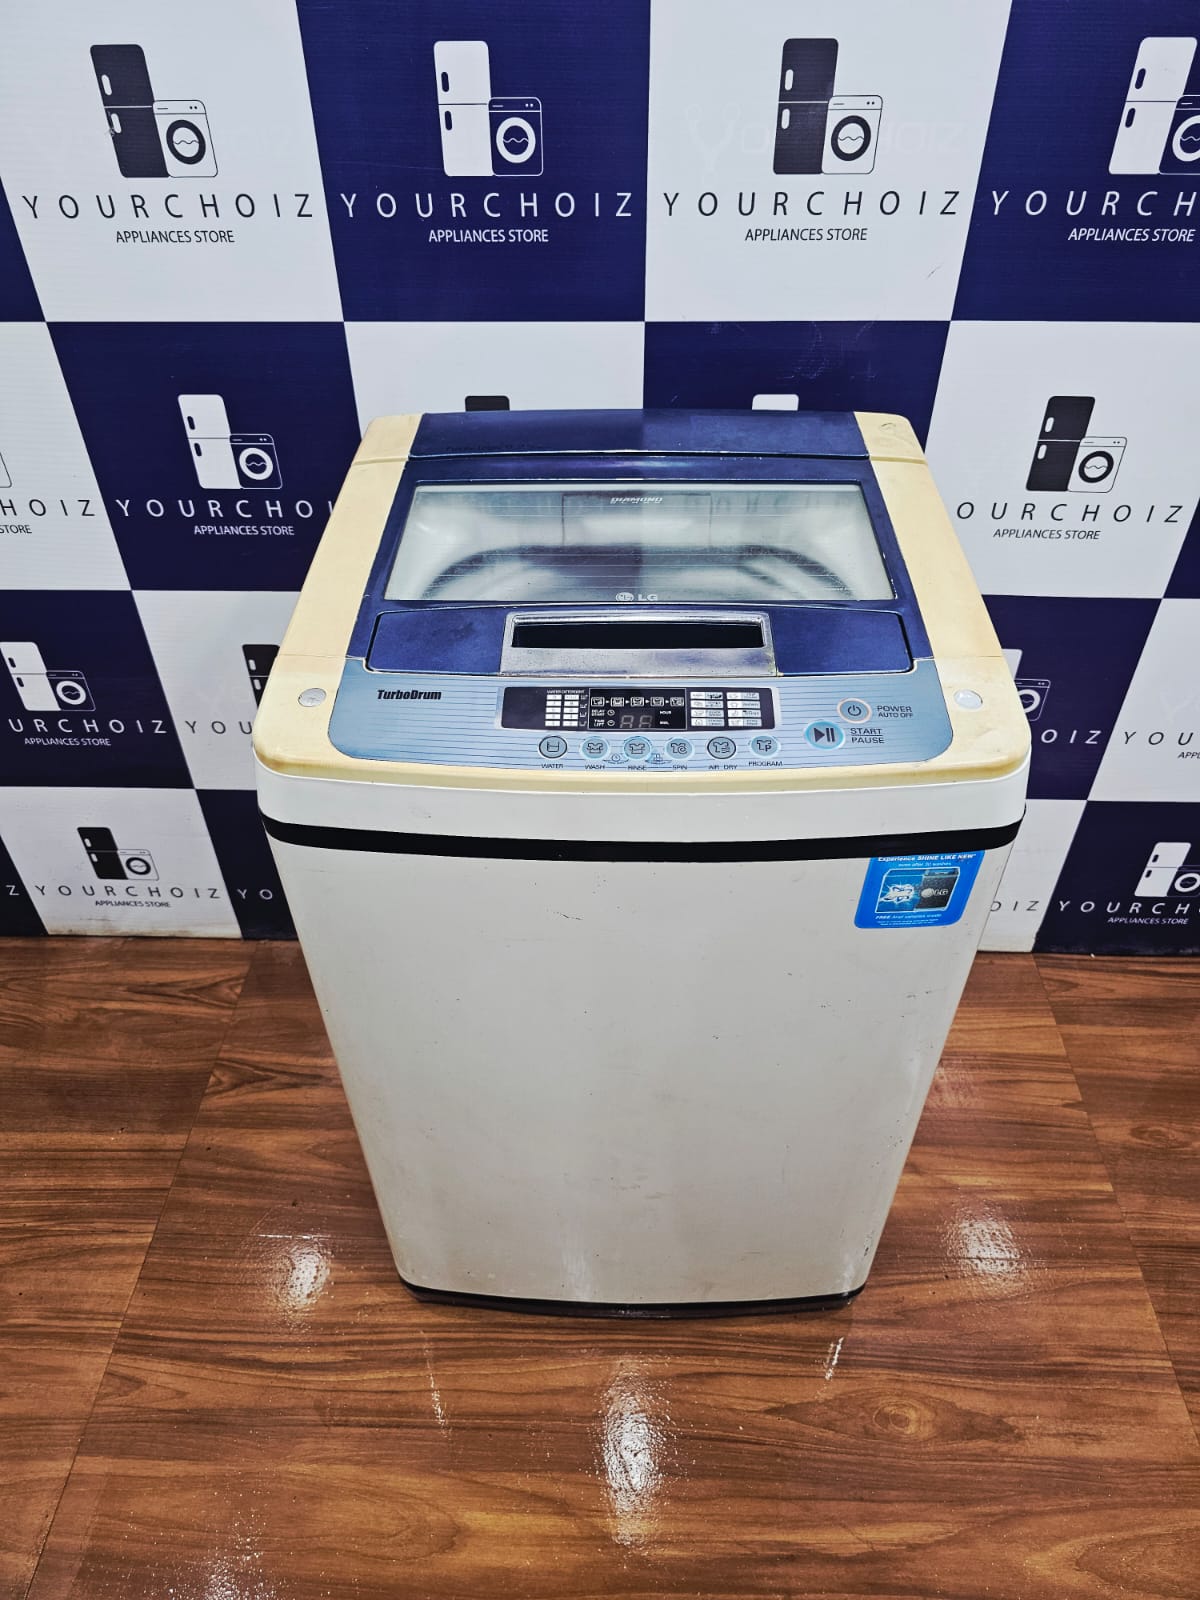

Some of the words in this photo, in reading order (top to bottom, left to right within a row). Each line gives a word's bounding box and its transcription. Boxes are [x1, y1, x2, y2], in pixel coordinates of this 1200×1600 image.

[22, 194, 312, 218] YOURCHOIZ
[341, 193, 631, 217] YOURCHOIZ
[664, 191, 959, 216] YOURCHOIZ
[993, 191, 1196, 216] YOURCH
[116, 230, 192, 243] APPLIANCES
[193, 230, 235, 243] STORE
[428, 229, 506, 243] APPLIANCES
[508, 229, 549, 243] STORE
[745, 229, 823, 241] APPLIANCES
[827, 228, 867, 240] STORE
[1067, 227, 1151, 242] APPLIANCES
[1151, 228, 1197, 242] STORE
[957, 502, 1183, 522] OURCHOIZ
[194, 525, 259, 536] APPLIANCES
[259, 525, 295, 536] STORE
[992, 528, 1063, 540] APPLIANCES
[1065, 529, 1102, 540] STORE
[377, 689, 442, 700] TurboDrum
[877, 705, 912, 713] POWER
[8, 718, 167, 734] URCHOIZ
[184, 720, 253, 735] YOU
[850, 727, 883, 735] START
[24, 737, 81, 746] APPLIANCES
[80, 738, 112, 746] STORE
[851, 736, 885, 744] PAUSE
[1041, 729, 1101, 744] OIZ
[1125, 732, 1193, 745] YOU
[34, 885, 220, 899] YOURCHOIZ
[1107, 916, 1160, 925] APPLIANCES
[1161, 917, 1189, 925] STORE
